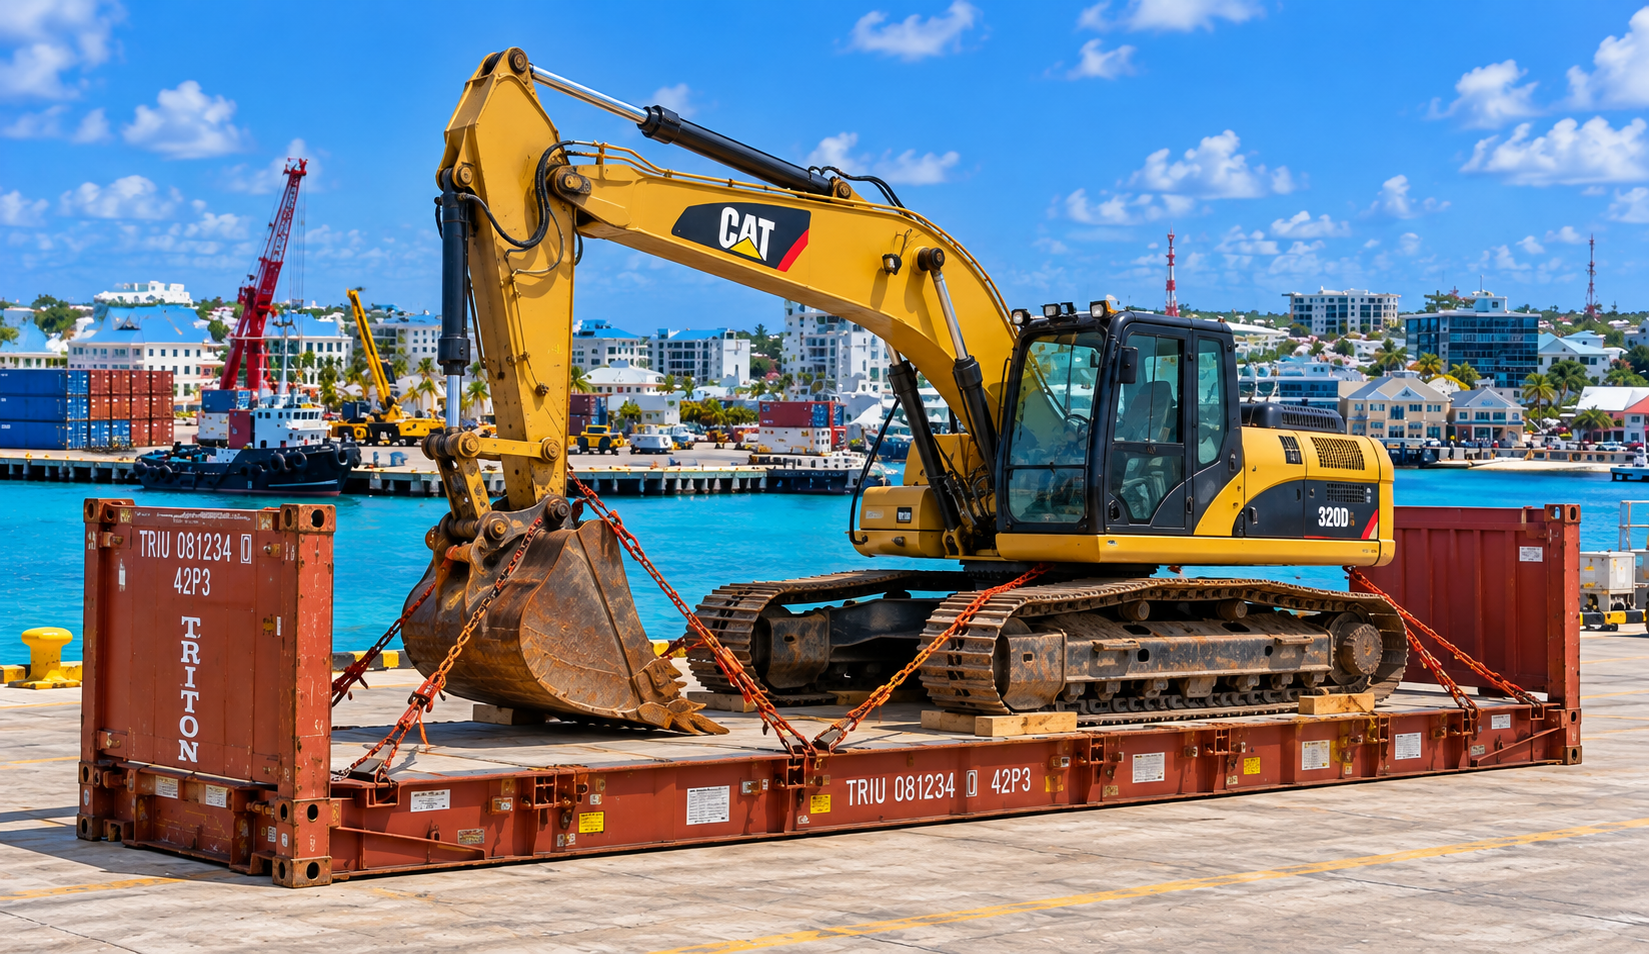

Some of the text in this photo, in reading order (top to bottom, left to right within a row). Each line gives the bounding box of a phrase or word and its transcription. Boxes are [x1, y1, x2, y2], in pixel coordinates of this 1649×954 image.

[718, 206, 776, 262] CAT
[1318, 505, 1349, 528] 320D
[139, 529, 170, 559] TRIU
[177, 531, 232, 563] 081234
[173, 566, 211, 597] 42P3
[178, 615, 201, 763] TRITON
[845, 776, 886, 806] TRIU
[894, 772, 956, 802] 081234
[991, 767, 1031, 794] 42P3
